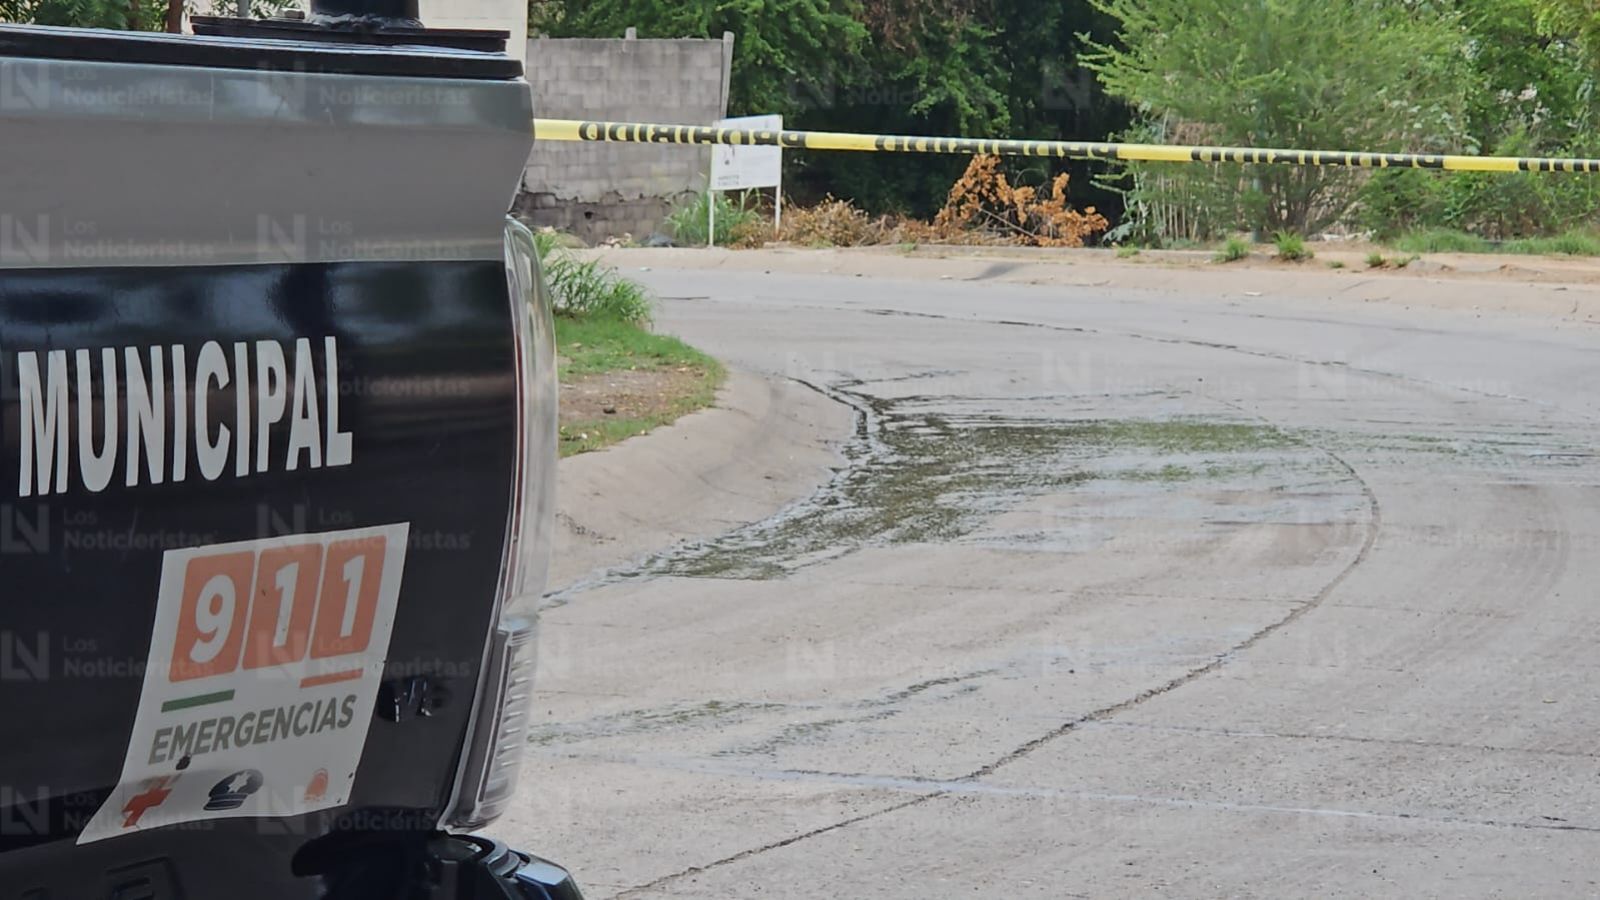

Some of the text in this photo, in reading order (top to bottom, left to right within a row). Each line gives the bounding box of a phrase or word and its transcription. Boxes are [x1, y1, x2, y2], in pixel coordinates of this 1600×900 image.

[18, 336, 353, 498] MUNICIPAL
[189, 554, 366, 664] 911
[147, 694, 358, 766] EMERGENCIAS
